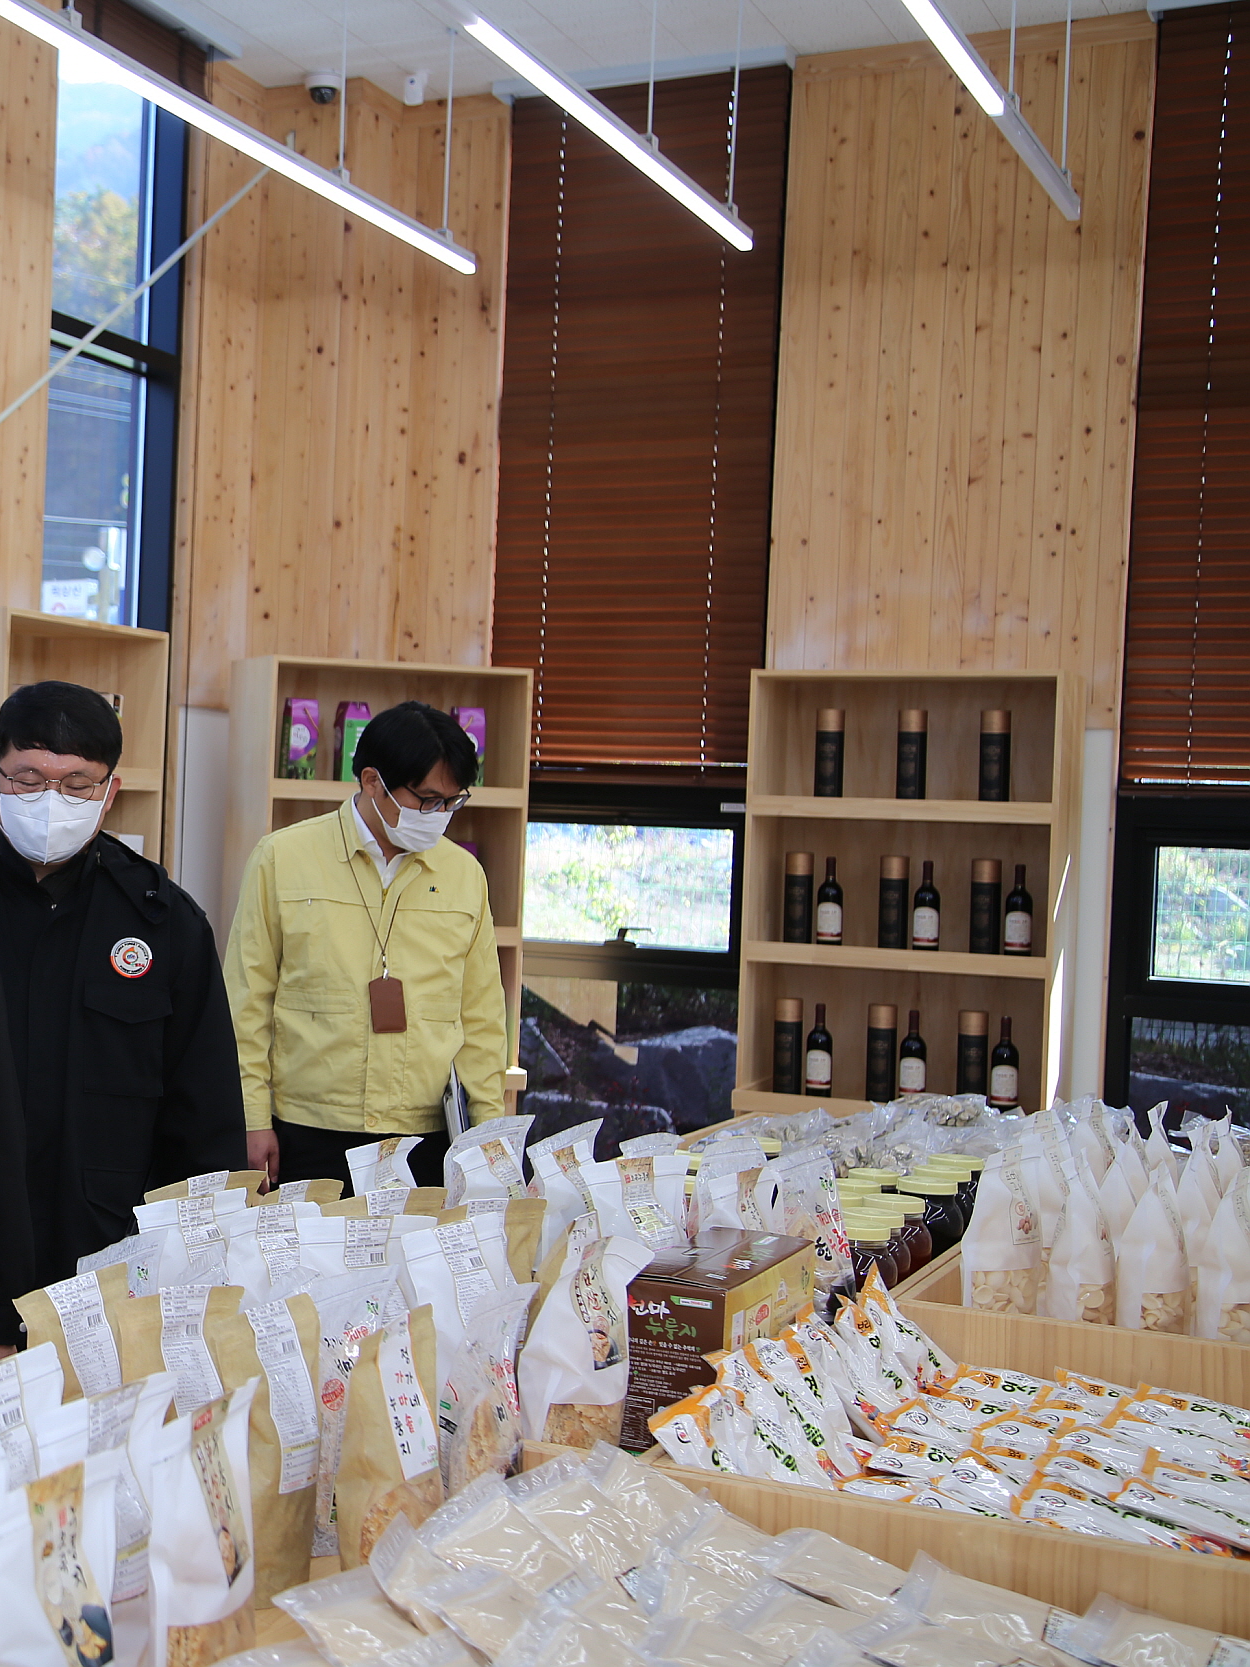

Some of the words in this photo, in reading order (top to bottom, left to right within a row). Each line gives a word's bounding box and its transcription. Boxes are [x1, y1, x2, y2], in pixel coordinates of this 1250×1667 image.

[645, 1317, 698, 1340] 누룽지
[400, 1348, 421, 1408] 정가네
[389, 1396, 411, 1455] 누룽지
